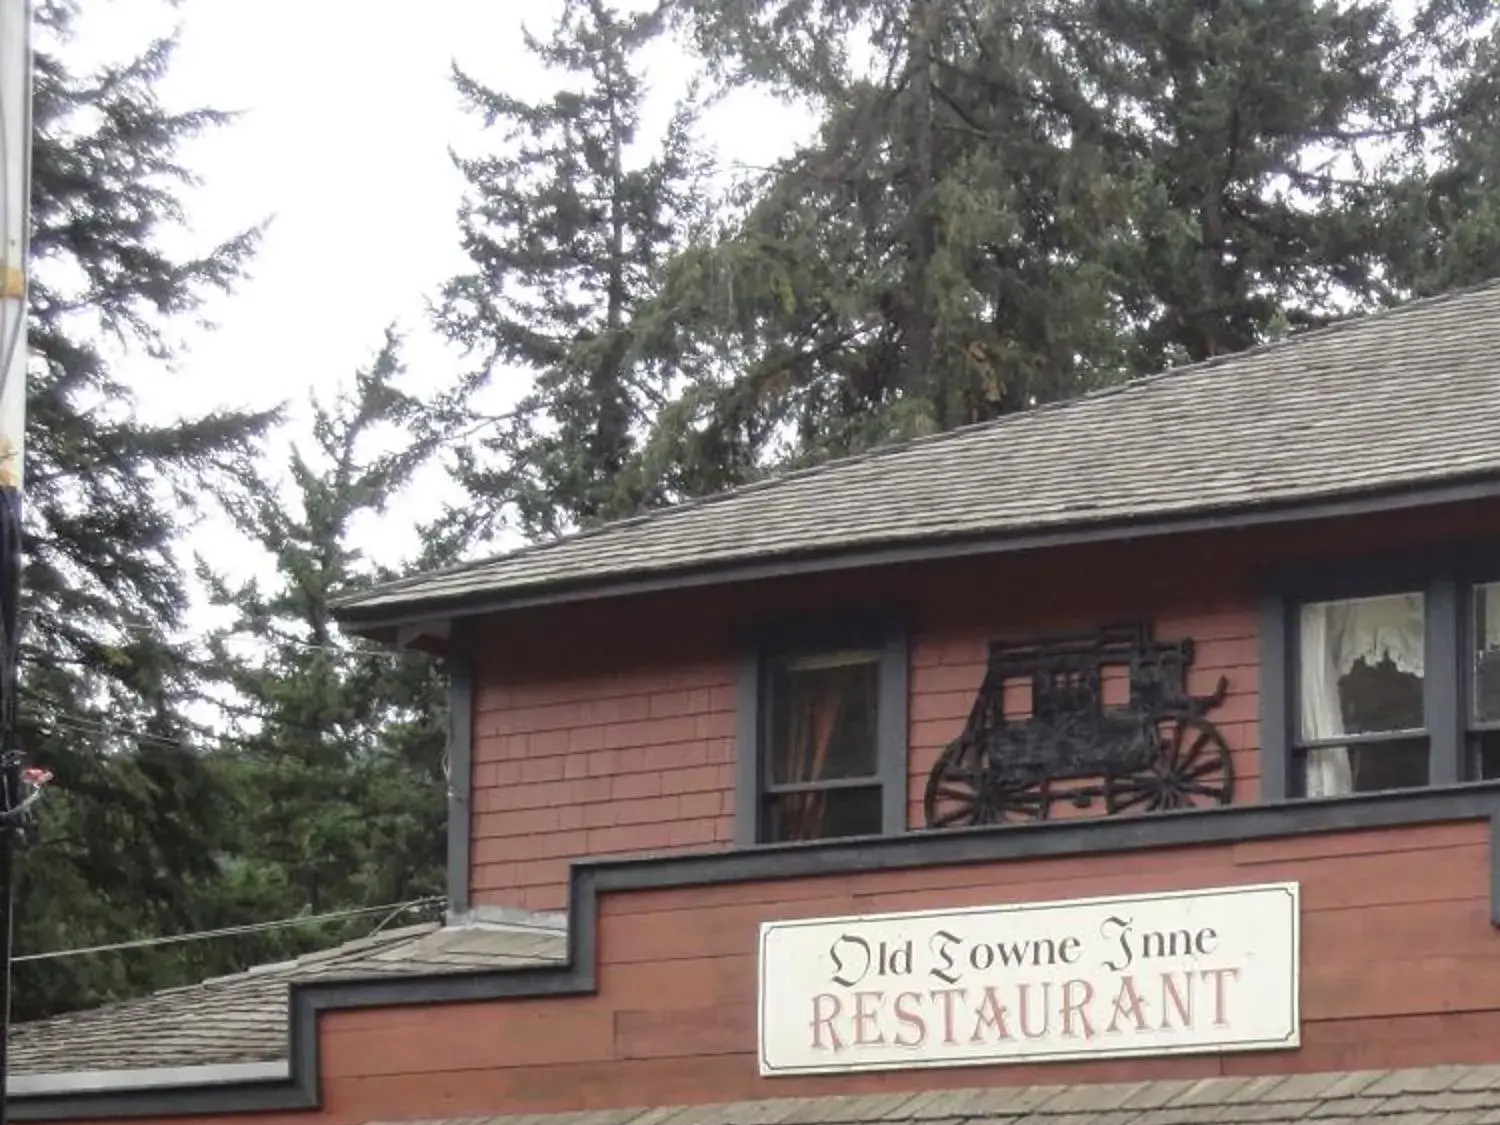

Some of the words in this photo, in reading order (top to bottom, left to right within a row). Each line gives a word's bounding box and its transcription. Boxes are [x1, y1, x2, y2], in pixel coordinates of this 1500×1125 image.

[830, 933, 913, 987] Old
[929, 930, 1081, 984] Towne
[1101, 915, 1219, 971] Inne
[810, 967, 1242, 1055] RESTAURANT
